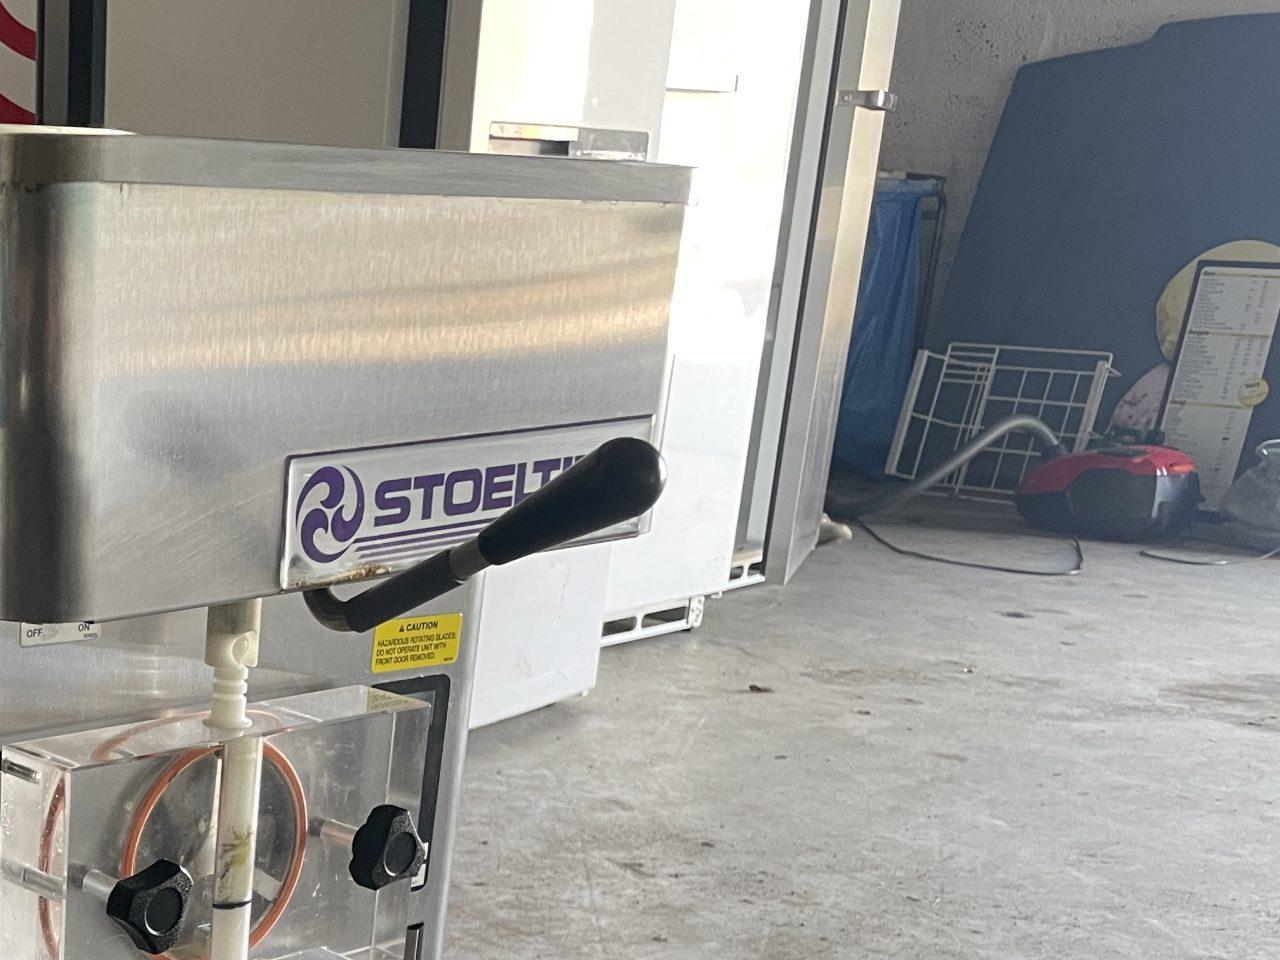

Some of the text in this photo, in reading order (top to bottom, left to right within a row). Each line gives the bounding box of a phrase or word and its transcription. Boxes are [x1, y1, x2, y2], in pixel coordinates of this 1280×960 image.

[373, 454, 587, 528] STOELT
[26, 623, 90, 638] OFF ON
[406, 621, 438, 631] CAUTION
[377, 637, 409, 647] HAZARDOUS
[410, 635, 434, 644] ROTATING
[376, 641, 447, 657] DO NOT OPERATE UNIT WITH
[375, 656, 392, 666] FRONT
[393, 655, 409, 664] DOOR
